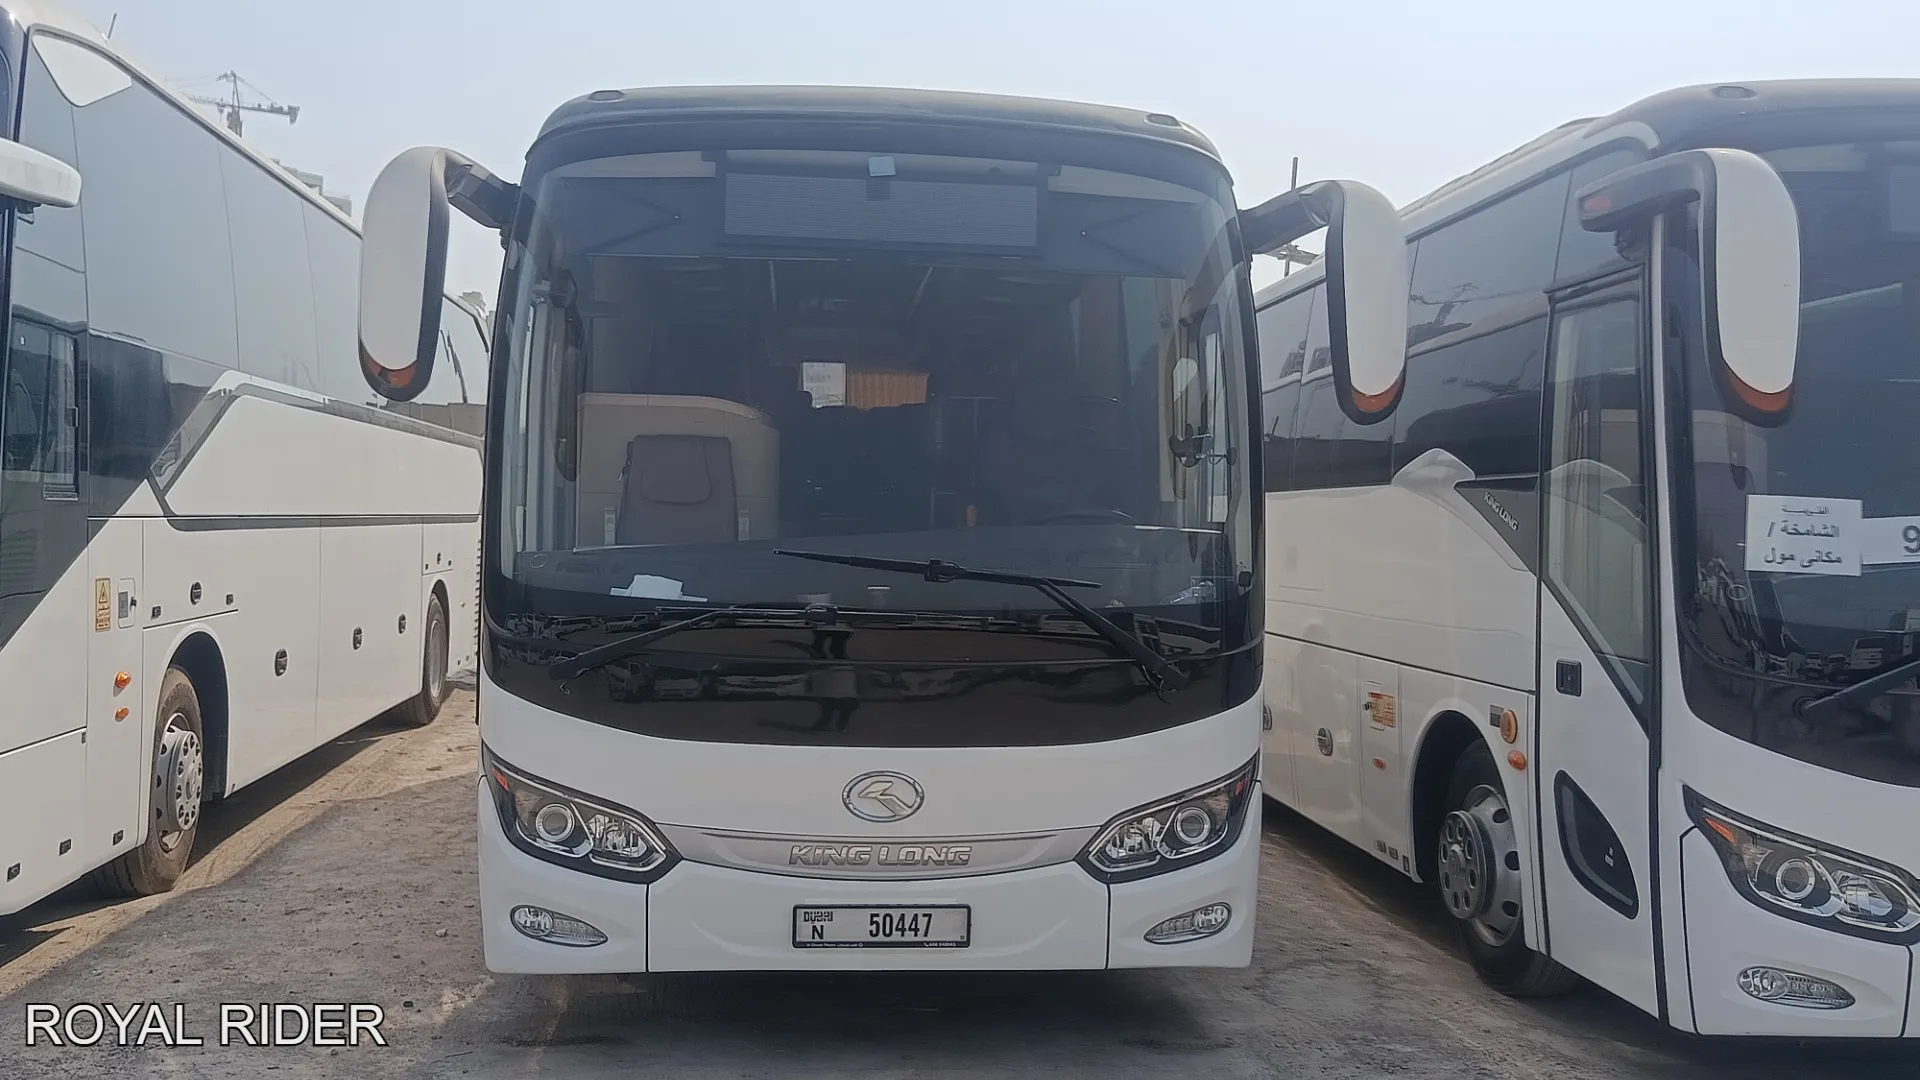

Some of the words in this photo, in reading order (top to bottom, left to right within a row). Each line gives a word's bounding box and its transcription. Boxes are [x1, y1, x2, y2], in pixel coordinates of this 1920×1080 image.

[1484, 491, 1501, 513] KING
[1499, 506, 1520, 531] LONG
[1764, 547, 1797, 565] مول
[789, 845, 872, 866] KING
[877, 846, 972, 866] LONG
[811, 924, 825, 940] N
[868, 913, 933, 938] 50447
